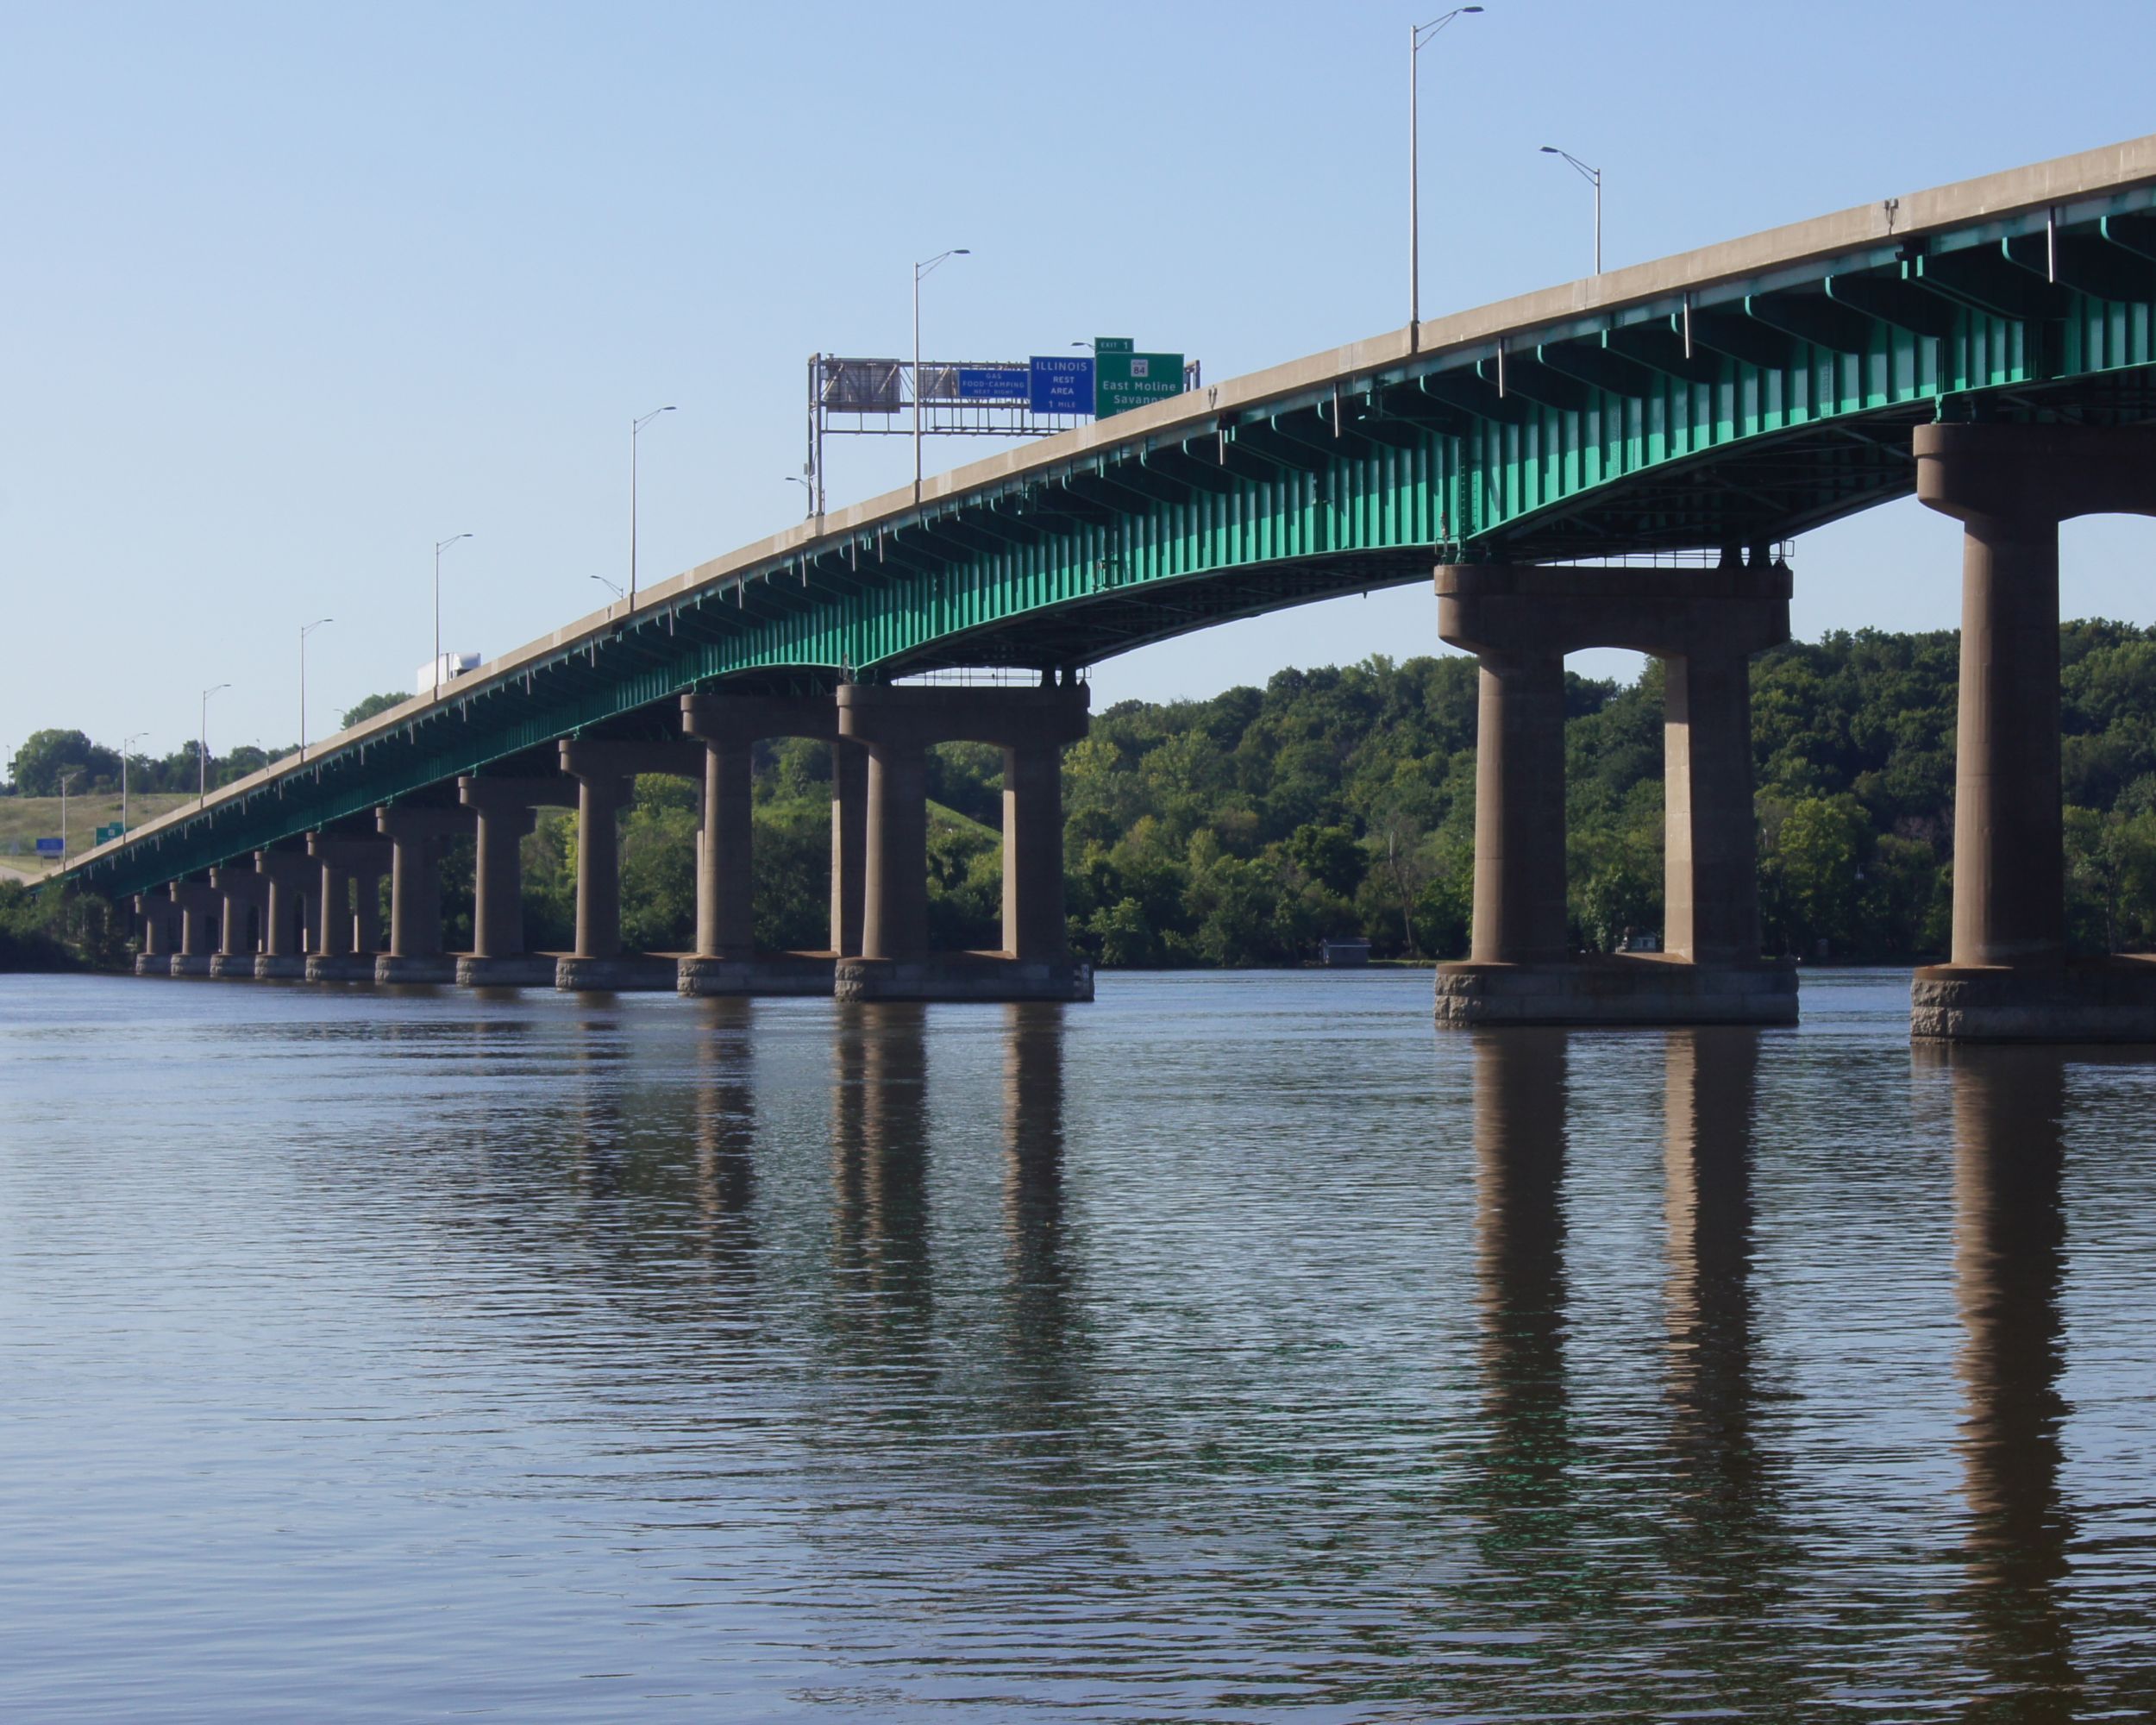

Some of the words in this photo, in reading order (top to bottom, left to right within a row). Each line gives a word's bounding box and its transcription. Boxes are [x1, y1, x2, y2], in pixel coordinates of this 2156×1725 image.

[1036, 361, 1087, 371] ILLINOIS
[1133, 366, 1145, 374] 84
[1103, 380, 1129, 390] East
[1135, 381, 1176, 391] Moline
